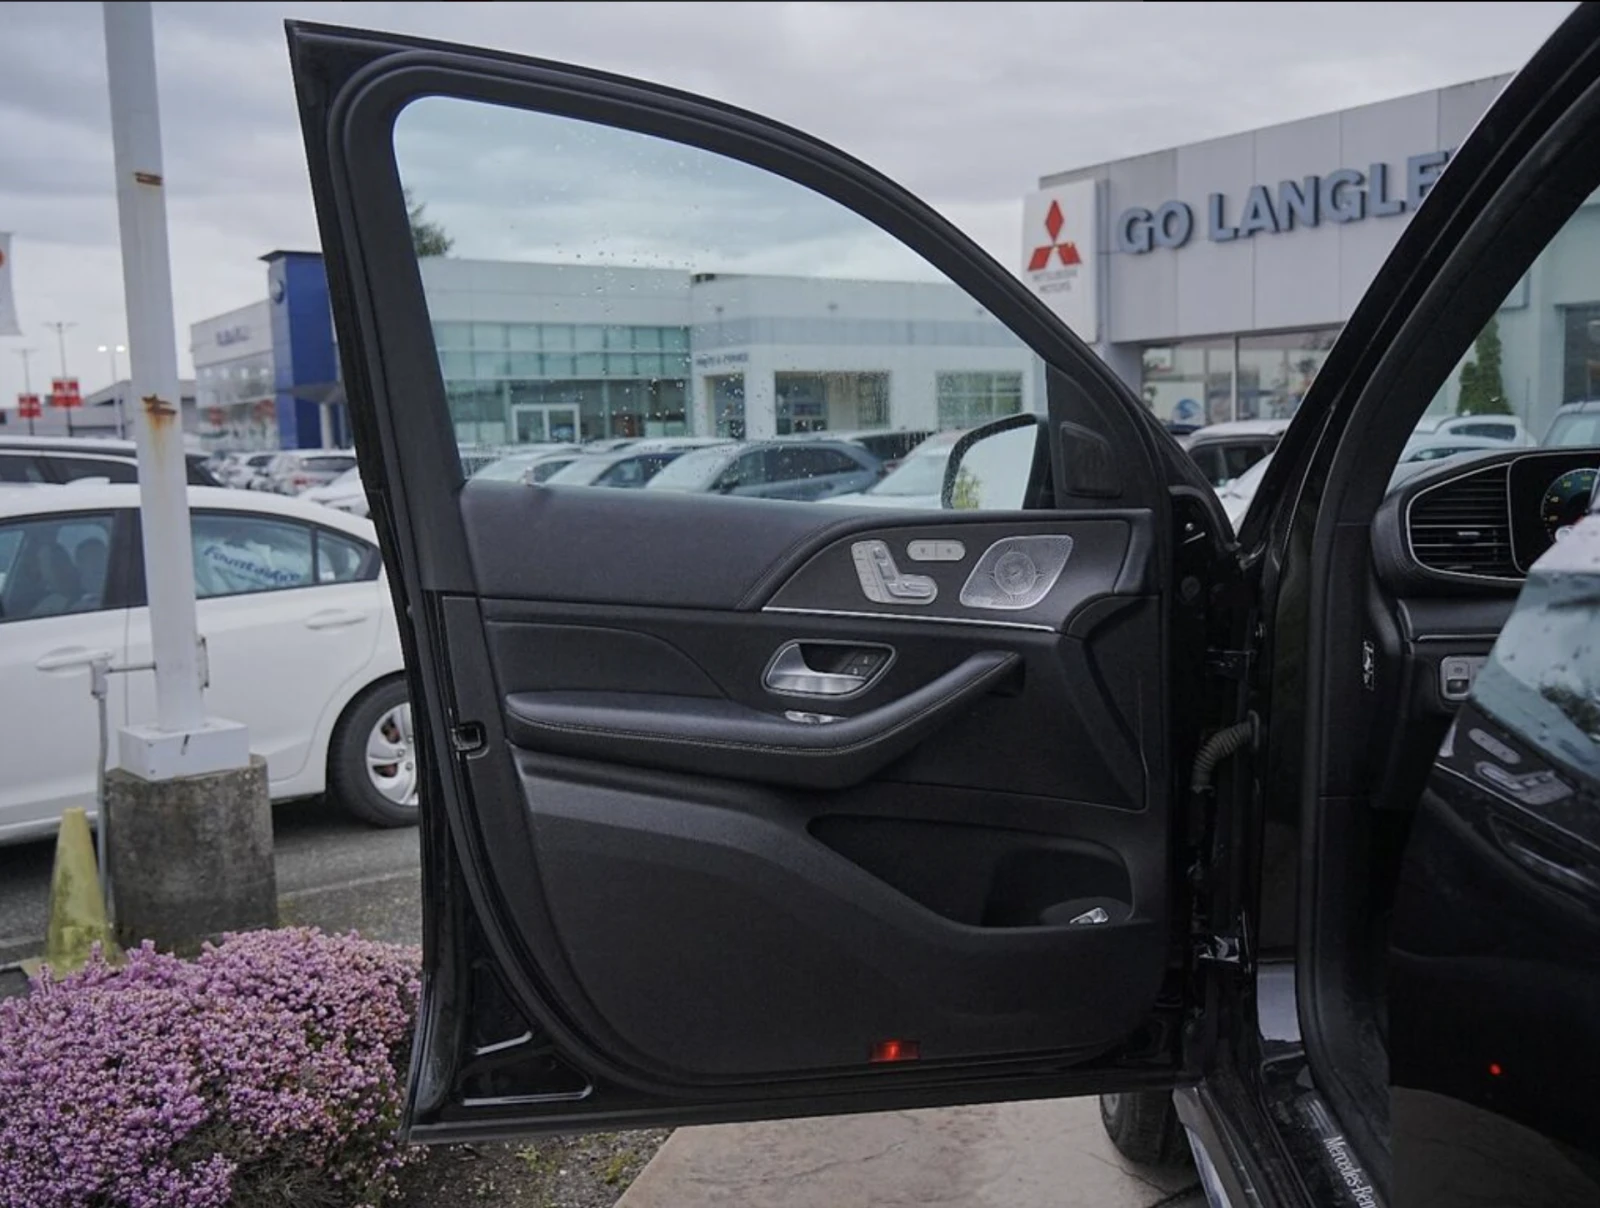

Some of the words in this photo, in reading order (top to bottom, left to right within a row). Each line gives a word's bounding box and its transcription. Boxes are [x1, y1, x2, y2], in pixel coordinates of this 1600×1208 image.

[1117, 200, 1194, 255] GO
[1208, 151, 1452, 242] LANGLE
[1323, 1135, 1378, 1208] Mercedes-Ben
